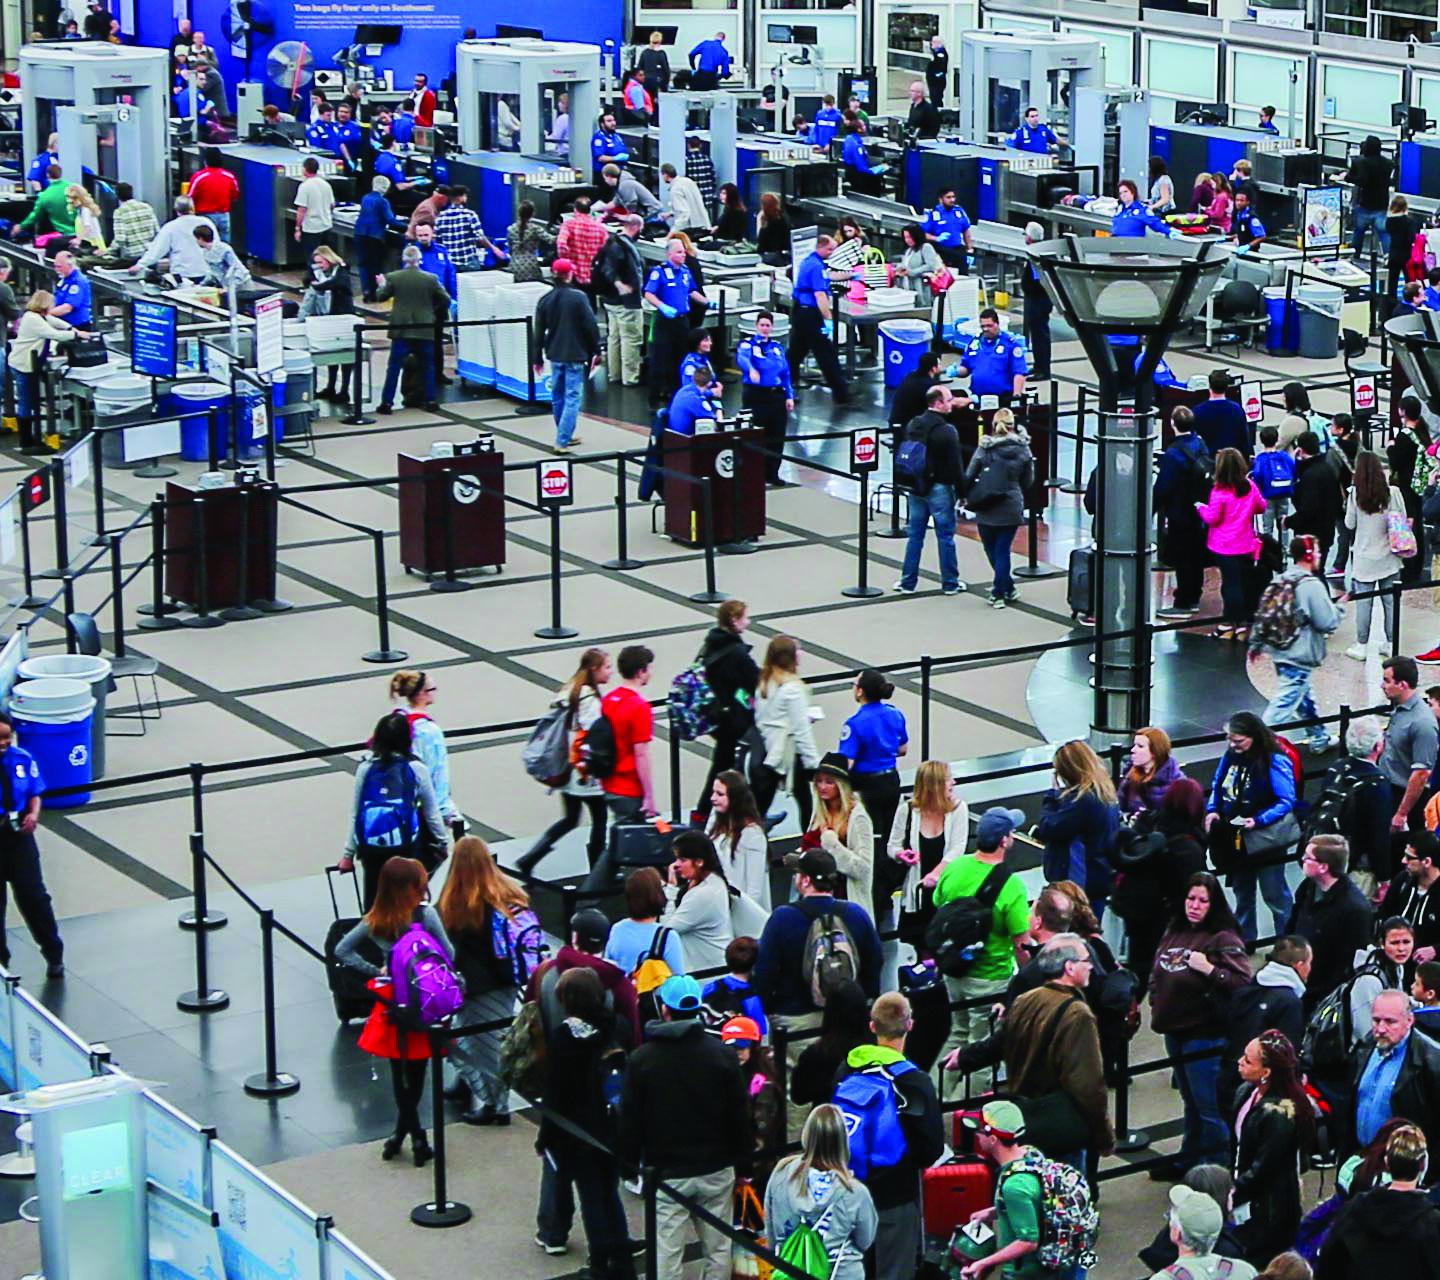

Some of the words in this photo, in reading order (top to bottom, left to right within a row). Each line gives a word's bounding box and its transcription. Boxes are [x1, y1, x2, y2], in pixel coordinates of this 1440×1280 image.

[1355, 390, 1374, 401] STOP
[855, 444, 876, 454] STOP
[541, 477, 570, 489] STOP
